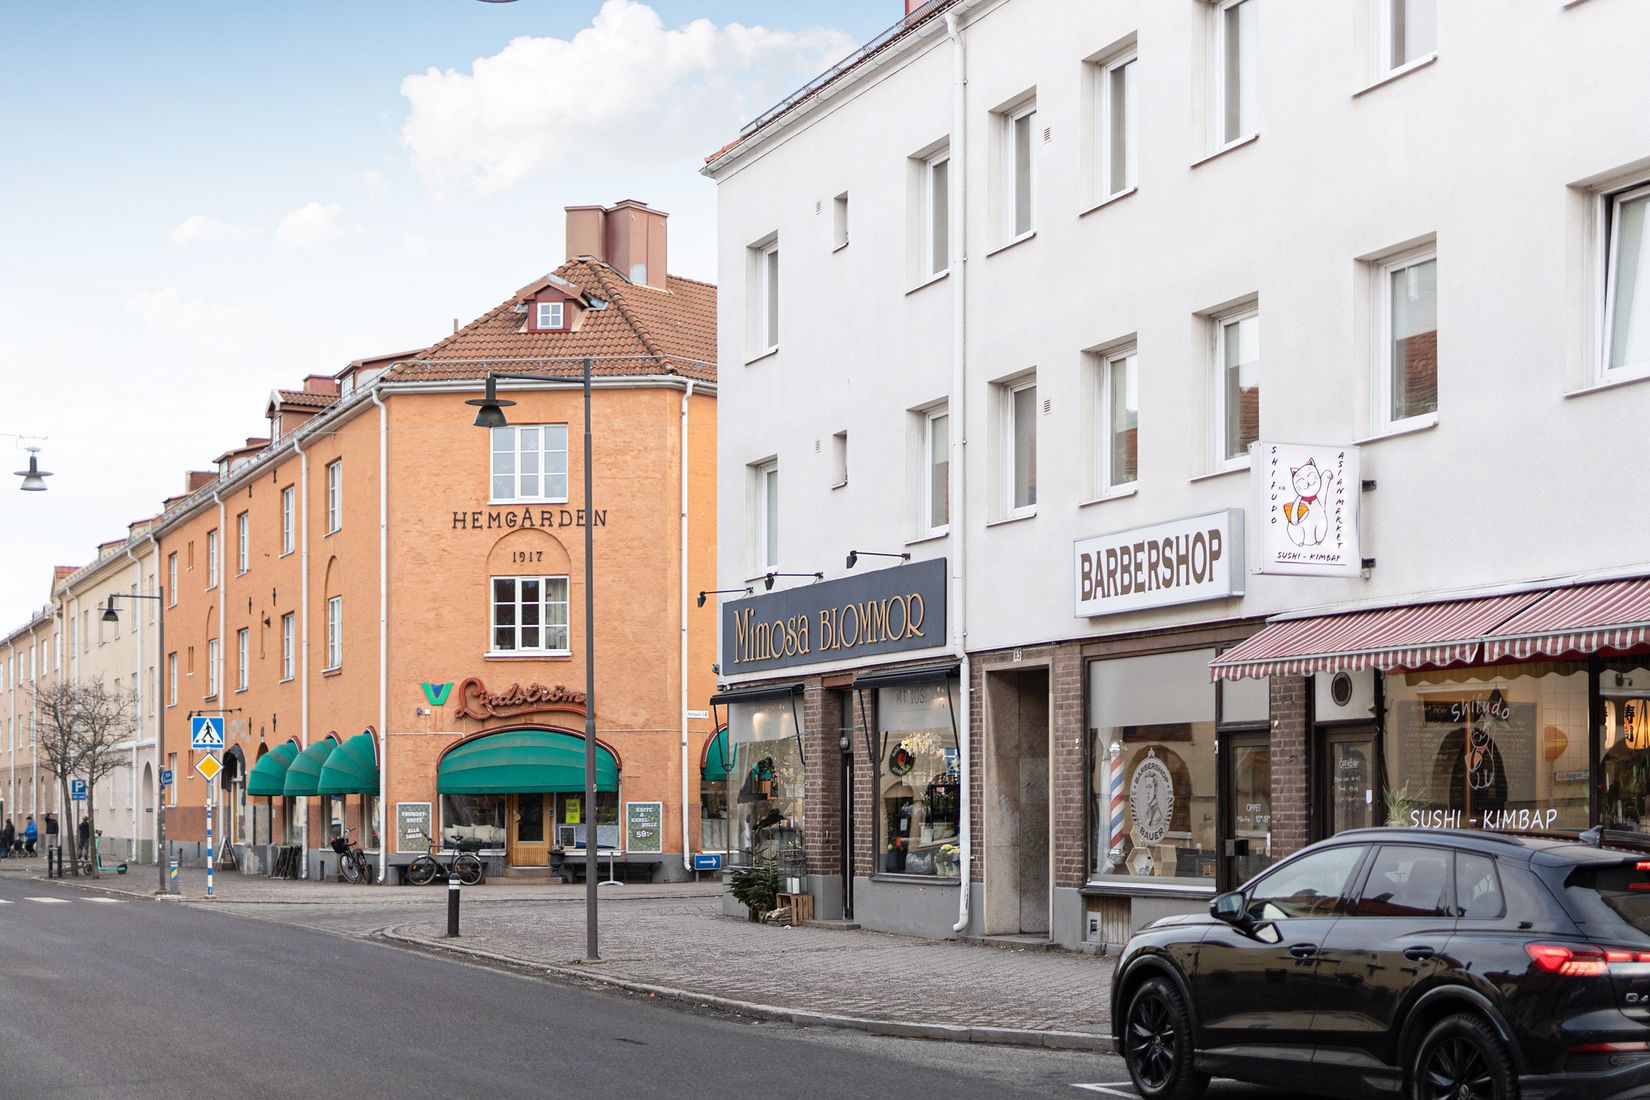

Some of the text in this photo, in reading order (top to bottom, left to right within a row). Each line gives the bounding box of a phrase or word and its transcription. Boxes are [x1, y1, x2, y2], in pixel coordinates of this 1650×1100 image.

[512, 551, 543, 563] 1917
[1080, 528, 1222, 602] BARBERSHOP
[1277, 551, 1301, 560] SUSHI
[733, 592, 925, 664] Mimosa BLOMMOR
[454, 677, 587, 720] Lindström
[1135, 762, 1169, 785] BARBERSHOP
[75, 782, 85, 793] P
[1410, 809, 1461, 829] SUSHI
[1483, 808, 1558, 830] KIMBAP
[1139, 827, 1165, 841] BAUER
